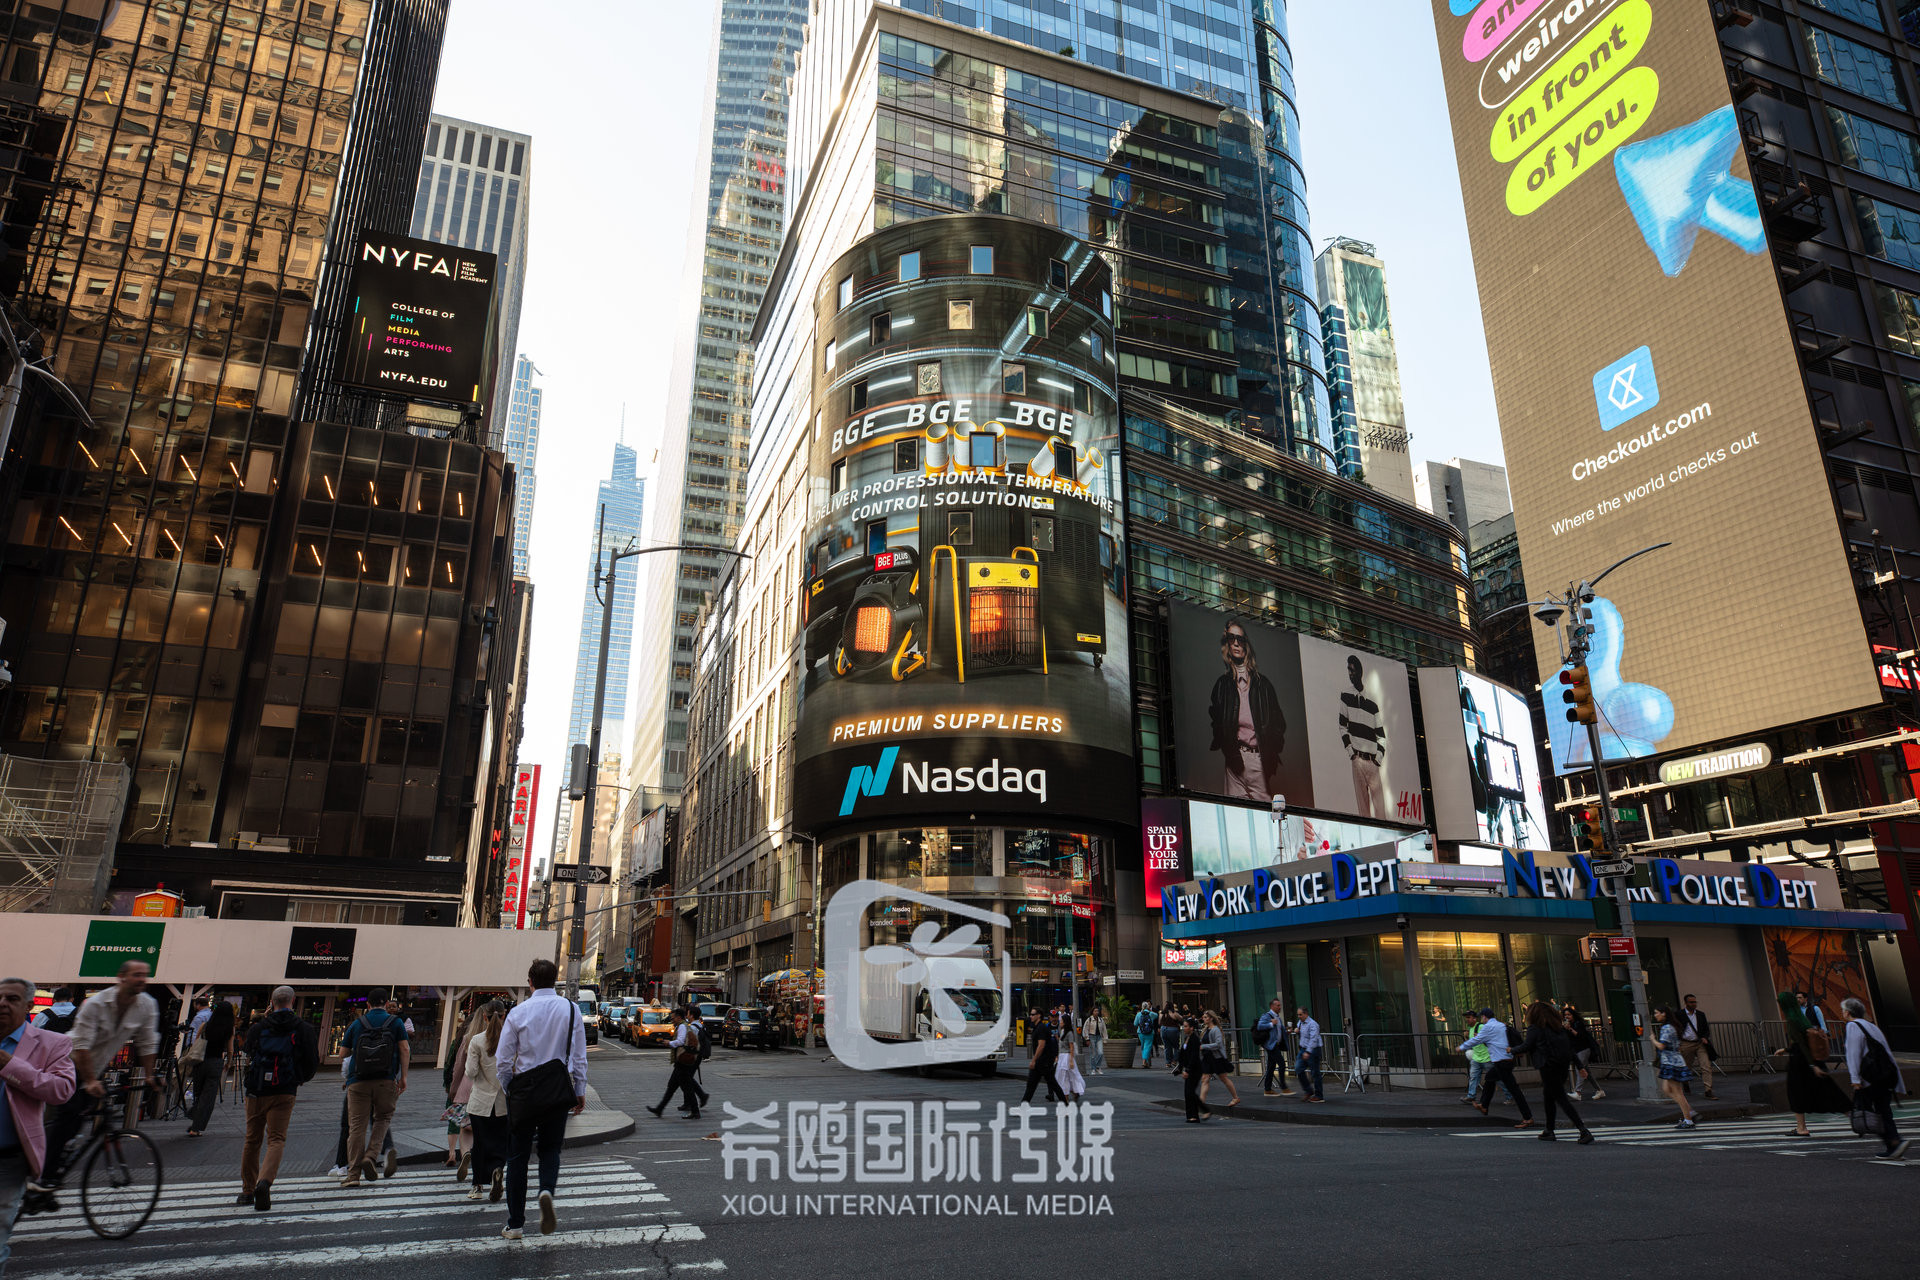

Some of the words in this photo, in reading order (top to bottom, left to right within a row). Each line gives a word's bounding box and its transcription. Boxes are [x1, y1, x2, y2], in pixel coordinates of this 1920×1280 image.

[1482, 0, 1526, 39] an
[1507, 106, 1537, 142] in
[1542, 23, 1628, 112] front
[1526, 146, 1556, 192] of
[1564, 98, 1639, 170] you.
[363, 242, 450, 277] NYFA
[460, 275, 488, 284] ACADEMY
[390, 314, 414, 323] FILM
[391, 303, 438, 317] COLLEGE
[441, 311, 455, 319] OF
[386, 336, 452, 353] PERFORMING
[388, 325, 420, 336] MEDIA
[384, 348, 410, 357] ARTS
[380, 370, 447, 388] NYFA.EDU
[906, 400, 972, 427] BGE
[1015, 404, 1073, 436] BGE
[832, 414, 877, 453] BGE
[1571, 402, 1712, 481] Checkout.com
[816, 488, 859, 523] DELIVER
[862, 472, 1004, 499] PROFESSIONAL
[1006, 473, 1114, 513] TEMPERATURE
[1551, 508, 1595, 536] Where
[1597, 497, 1621, 515] the
[1624, 473, 1665, 503] world
[1668, 448, 1726, 483] checks
[1730, 431, 1760, 455] out
[851, 495, 929, 522] CONTROL
[934, 490, 1043, 511] SOLUTIONS
[878, 555, 891, 567] BGE
[833, 715, 923, 742] PREMIUM
[933, 713, 1064, 733] SUPPLIERS
[1666, 748, 1763, 782] NEWTRADITION
[902, 758, 1047, 803] Nasdaq
[514, 772, 530, 825] PARK
[1397, 791, 1422, 822] H&M
[1147, 826, 1177, 834] SPAIN
[1148, 834, 1178, 850] UP
[1149, 850, 1178, 858] YOUR
[1149, 858, 1179, 870] LIFE
[1614, 863, 1629, 871] WAY
[504, 857, 521, 912] PARK
[1161, 886, 1199, 925] NEW
[1200, 878, 1250, 919] YORK
[1253, 867, 1325, 912] POLICE
[1331, 853, 1399, 901] DEPT
[1502, 848, 1576, 898] NEW
[1651, 858, 1750, 907] POLICE
[1751, 864, 1818, 909] DEPT
[1027, 906, 1047, 914] Nasdaq
[89, 945, 142, 953] STARBUCKS
[1167, 950, 1180, 962] 50
